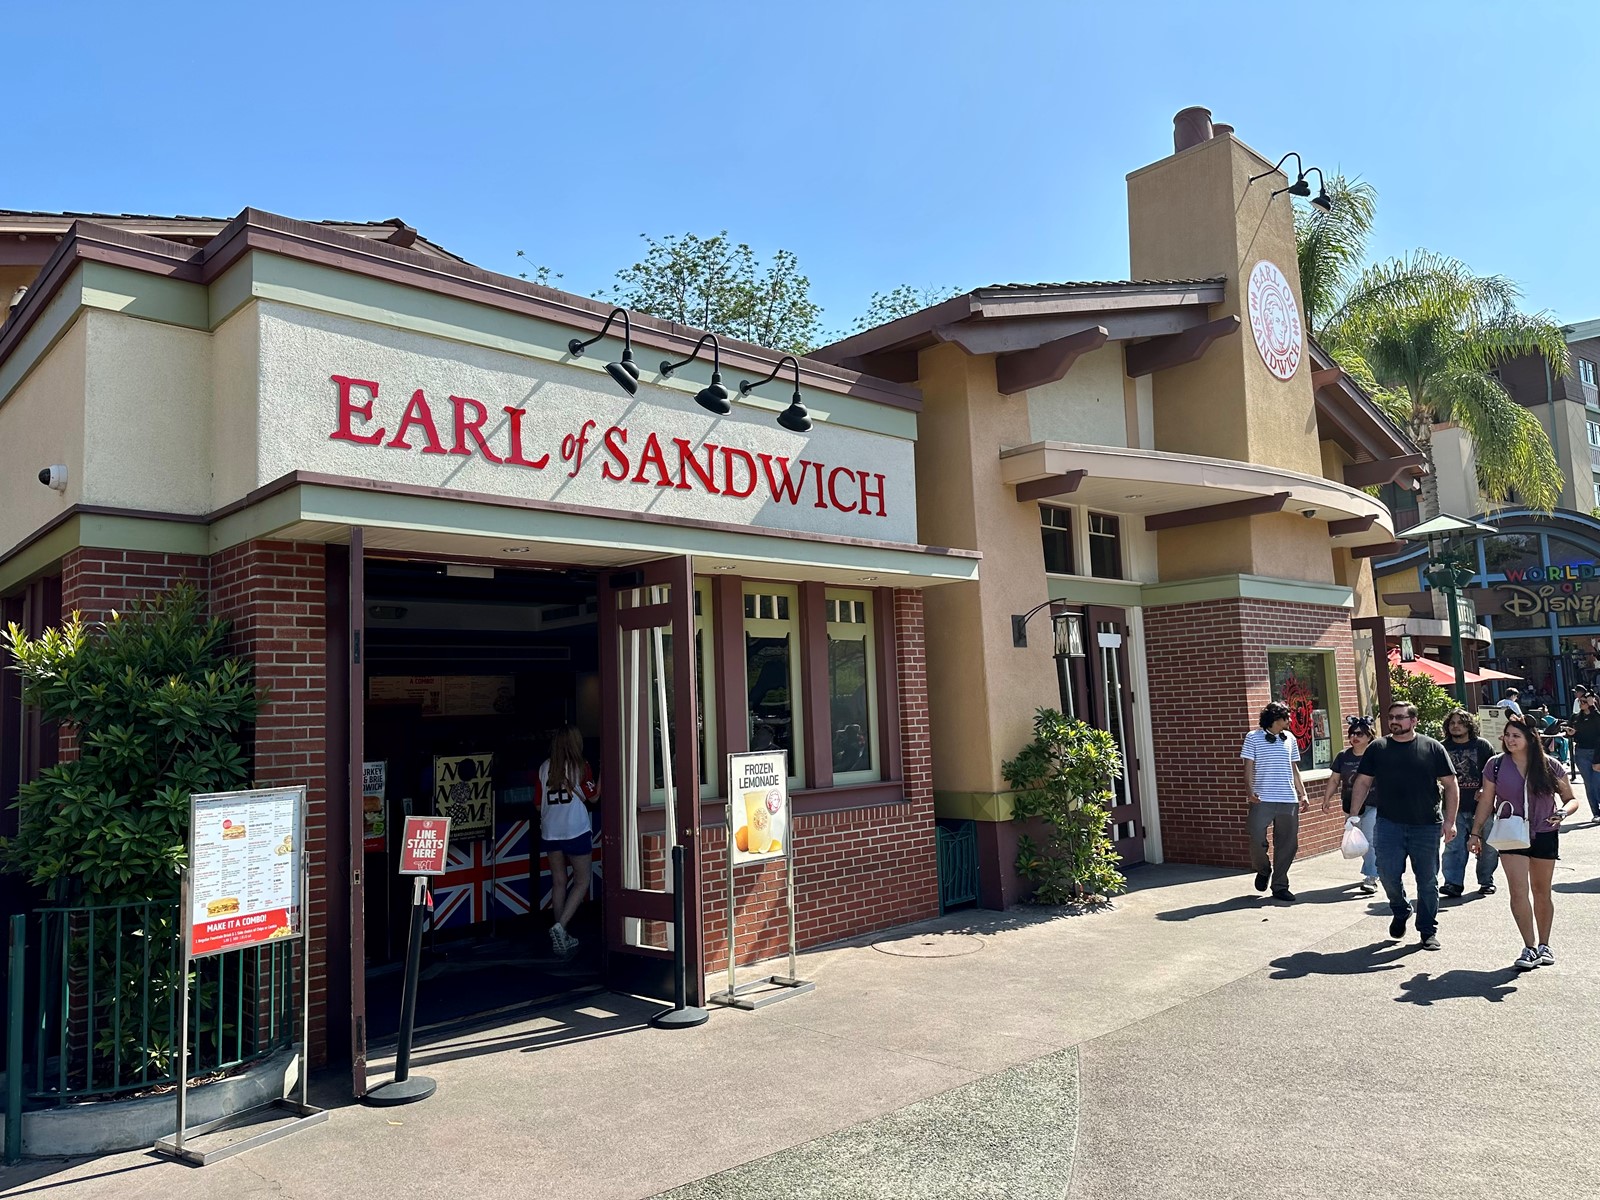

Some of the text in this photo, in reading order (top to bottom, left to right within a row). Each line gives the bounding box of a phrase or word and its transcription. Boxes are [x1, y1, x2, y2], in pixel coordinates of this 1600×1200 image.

[1253, 265, 1296, 313] EARL OF
[1252, 315, 1300, 376] SANDWICH
[329, 374, 888, 518] EARL of SANDWICH
[1505, 564, 1595, 583] WORLD
[1561, 582, 1582, 593] OF
[744, 762, 774, 776] FROZEN
[369, 775, 383, 784] BRIE
[738, 774, 780, 789] LEMONADE
[416, 829, 437, 840] LINE
[407, 839, 444, 849] STARTS
[412, 848, 437, 858] HERE
[207, 914, 267, 933] MAKE IT A COMBO!
